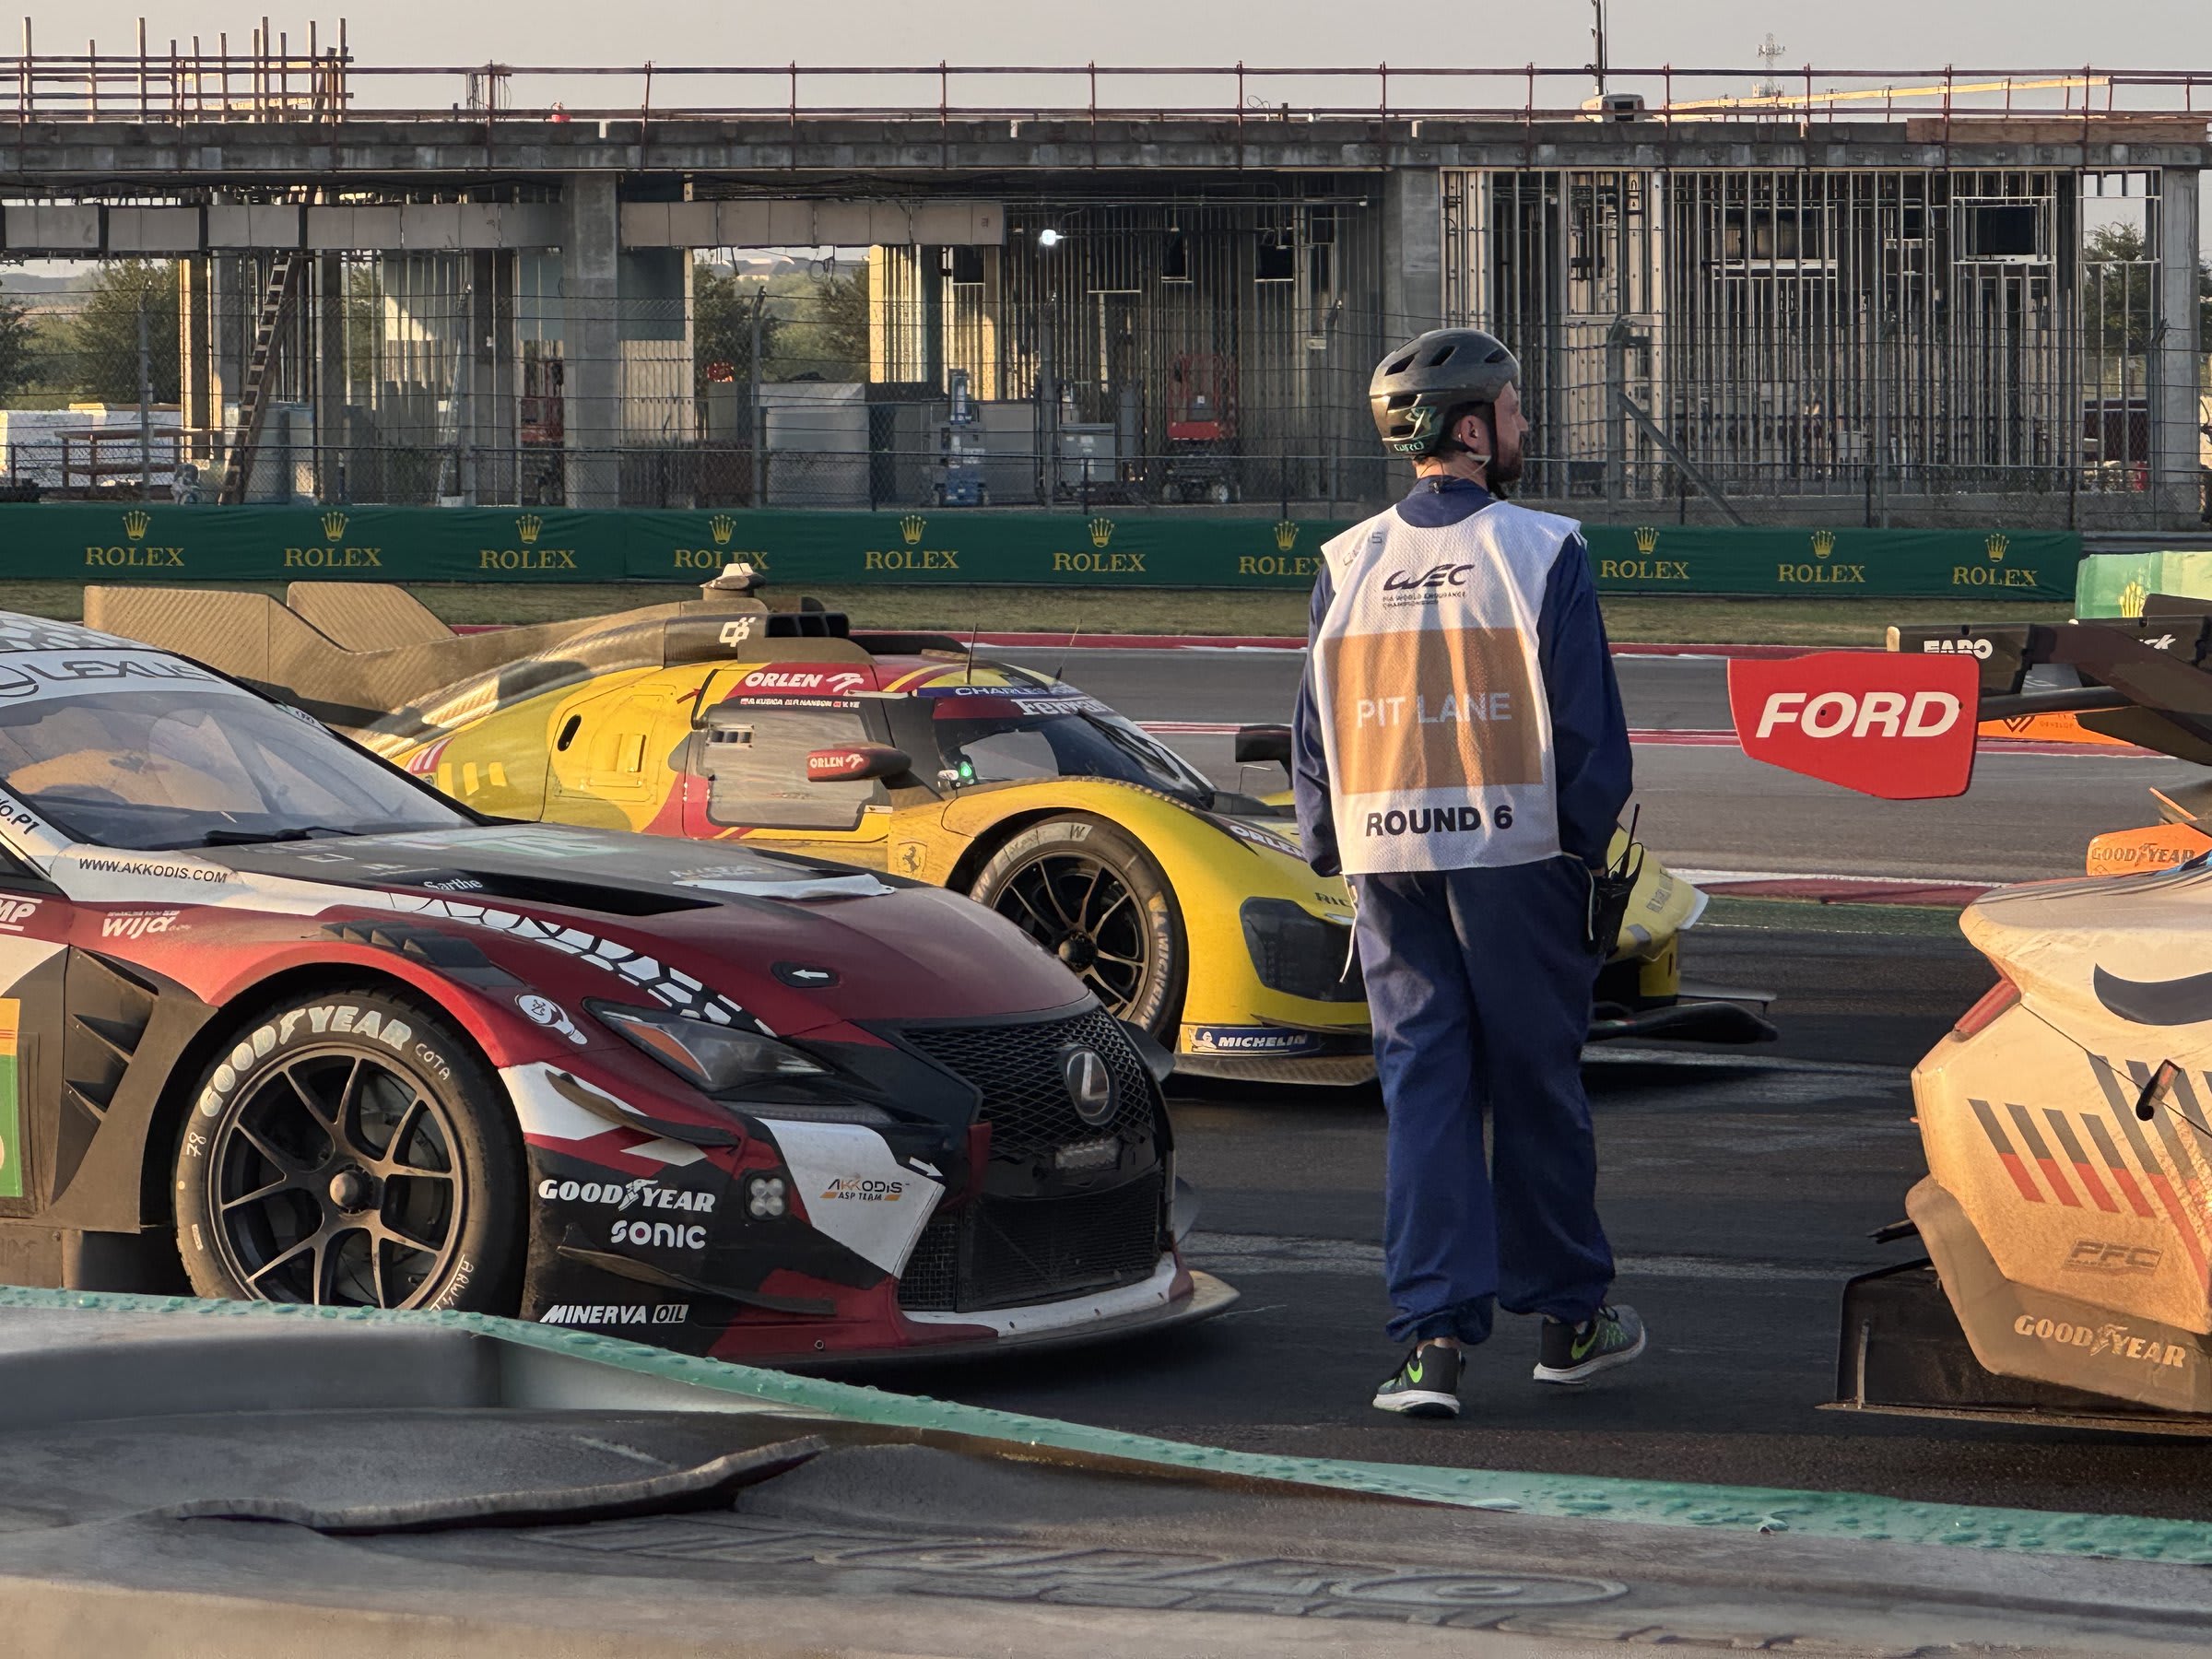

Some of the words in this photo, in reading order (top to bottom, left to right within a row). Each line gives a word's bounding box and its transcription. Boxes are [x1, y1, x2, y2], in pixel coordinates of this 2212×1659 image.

[85, 547, 184, 567] ROLEX
[284, 547, 382, 568] ROLEX
[479, 549, 577, 570] ROLEX
[865, 551, 959, 570] ROLEX
[1053, 553, 1147, 572] ROLEX
[1383, 564, 1475, 591] WEC
[1601, 559, 1689, 579] ROLEX
[1778, 564, 1865, 583] ROLEX
[1952, 567, 2039, 586] ROLEX
[745, 672, 824, 688] ORLEN
[1357, 697, 1406, 728] PIT
[1418, 691, 1512, 724] LANE
[1756, 691, 1960, 738] FORD
[809, 756, 844, 769] ORLEN
[1365, 806, 1481, 837] ROUND
[1493, 805, 1513, 830] 6
[79, 858, 228, 884] WWW.AKKODIS.COM
[1218, 1033, 1307, 1048] MICHELIN
[200, 1005, 412, 1117] GOODYEAR
[415, 1043, 450, 1081] COTA
[186, 1132, 207, 1158] 78
[538, 1179, 716, 1213] GOODYEAR
[539, 1304, 647, 1324] MINERVA
[655, 1305, 687, 1324] OIL
[2014, 1314, 2186, 1368] GOODYEAR
